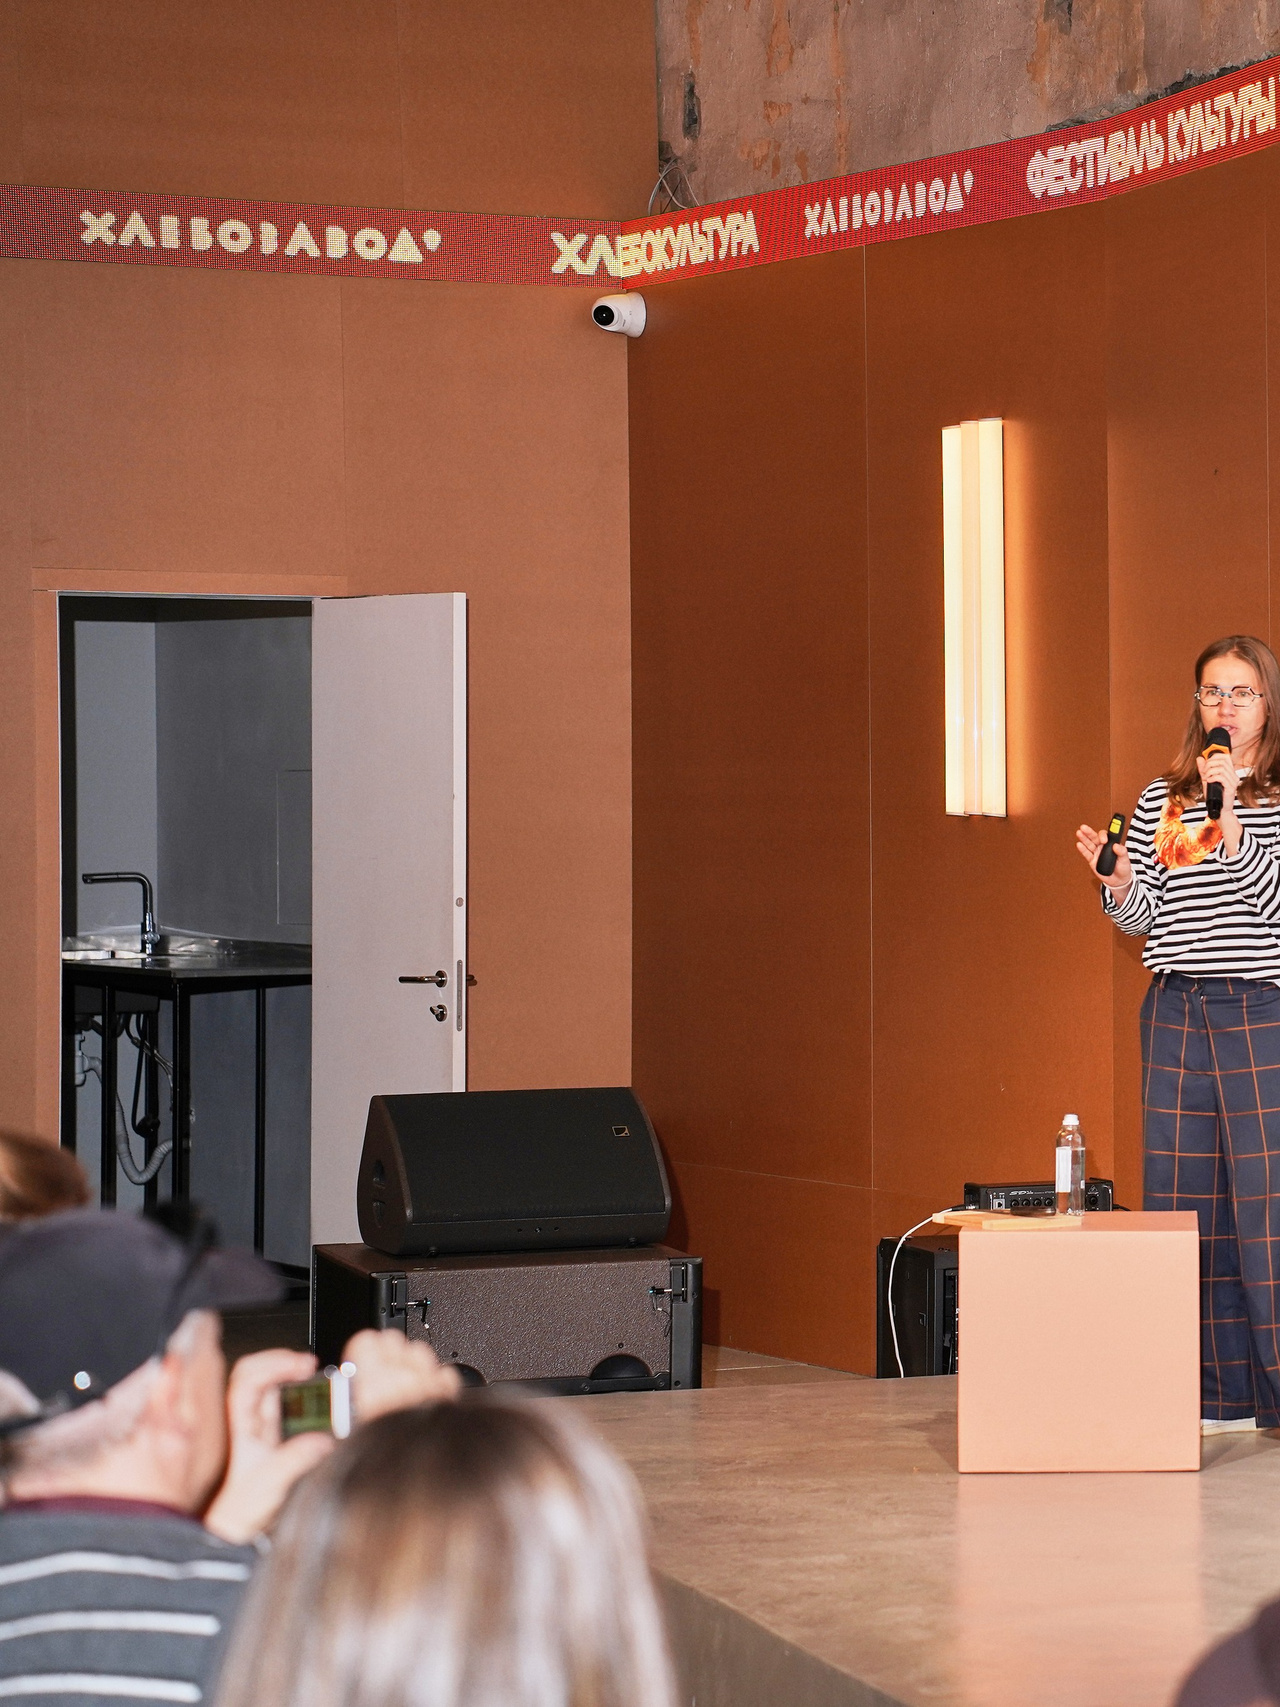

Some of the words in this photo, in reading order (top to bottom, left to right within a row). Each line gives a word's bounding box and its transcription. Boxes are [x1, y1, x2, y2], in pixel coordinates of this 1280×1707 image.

[1026, 136, 1164, 199] ФЕСТИВАЛЬ
[1167, 76, 1276, 165] КУЛЬТУРЫ
[551, 210, 760, 278] ХЛЕБОКУЛЬТУРА
